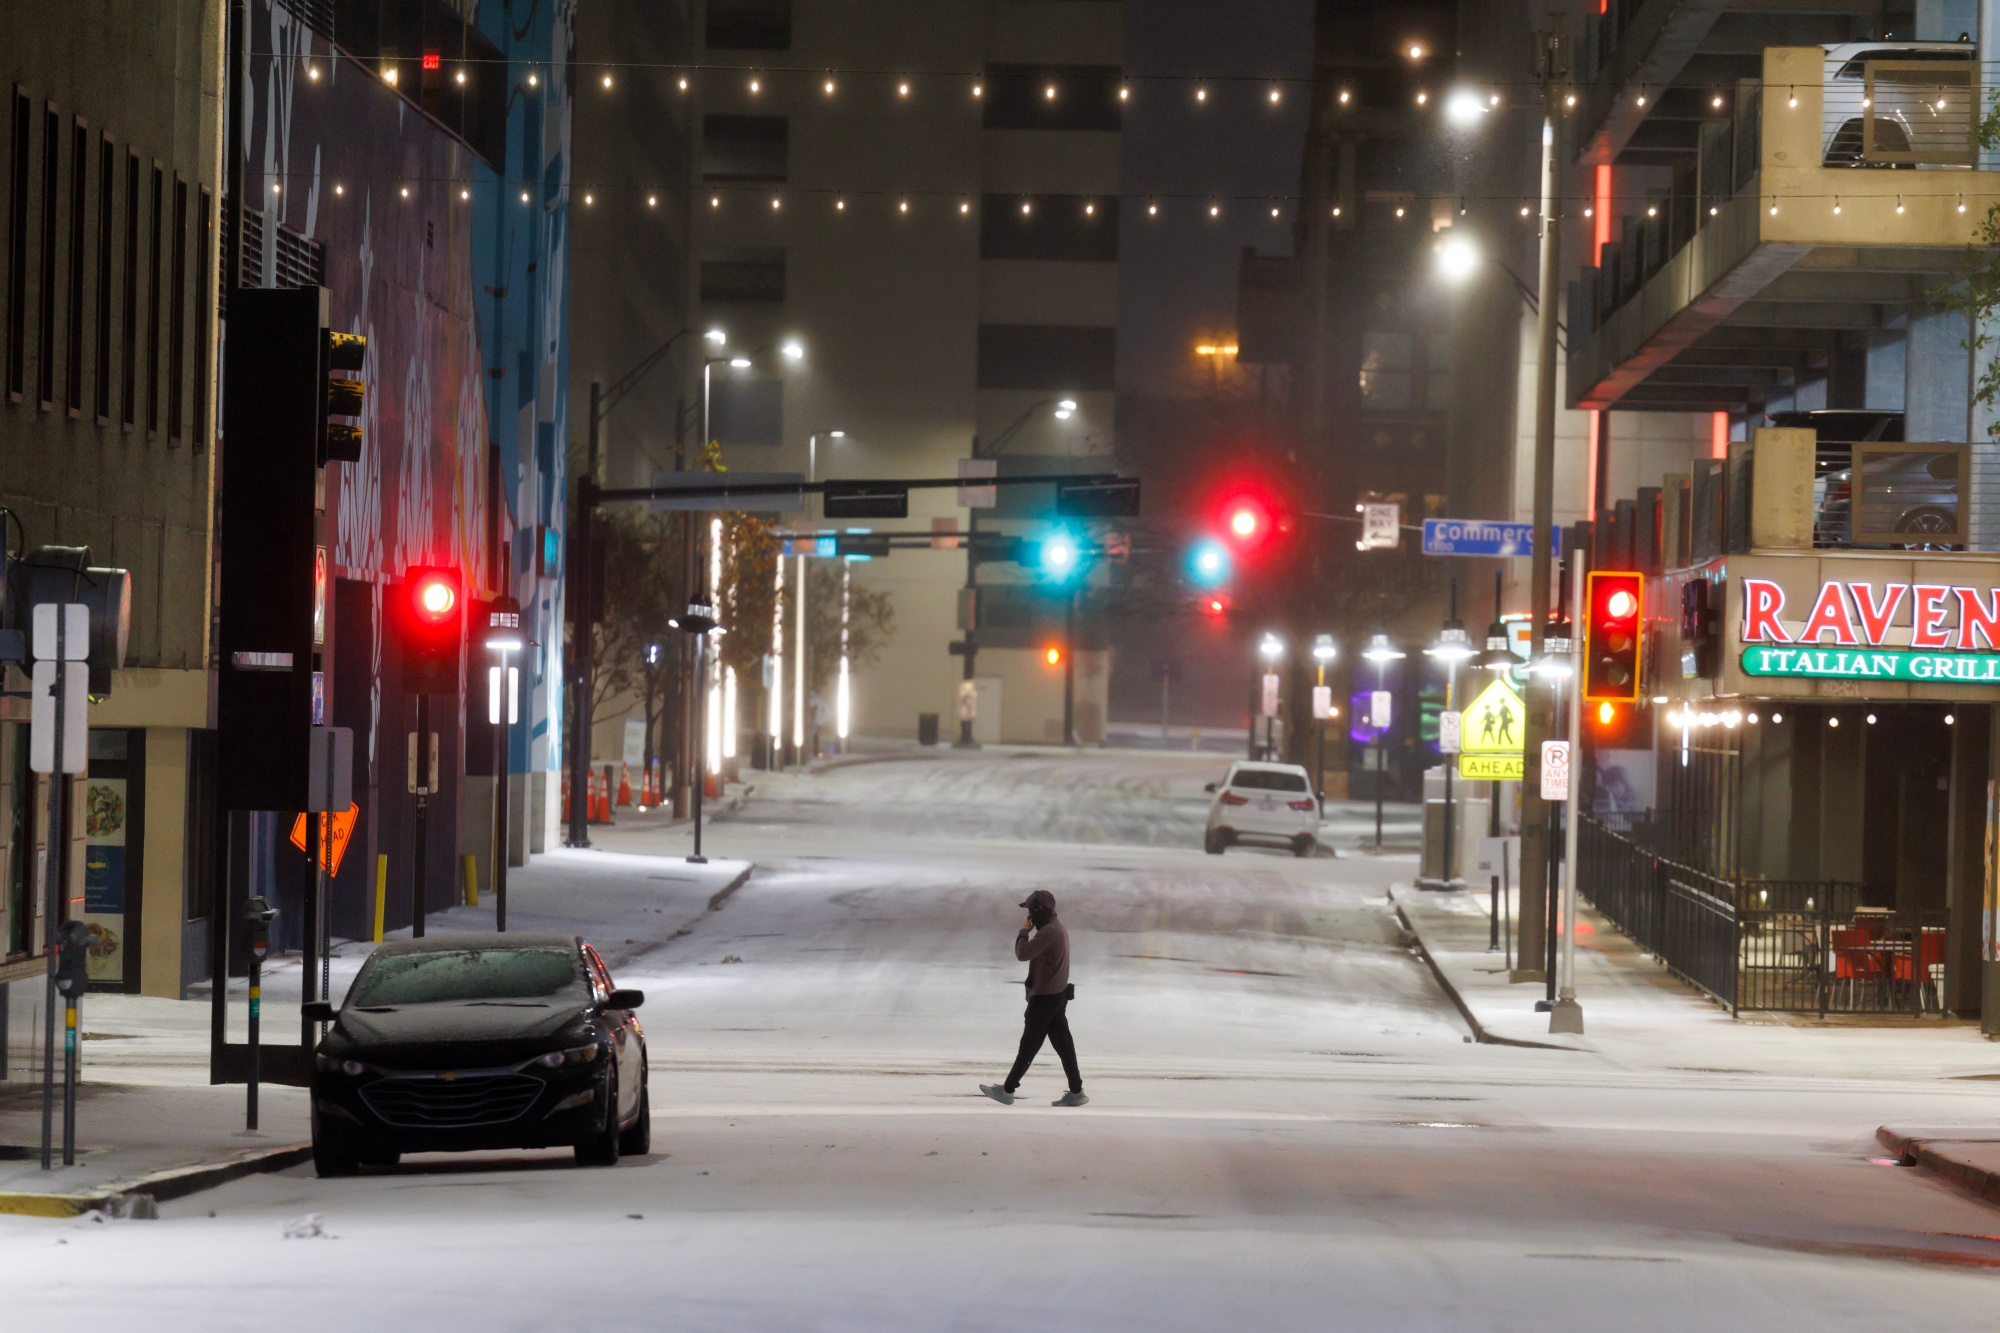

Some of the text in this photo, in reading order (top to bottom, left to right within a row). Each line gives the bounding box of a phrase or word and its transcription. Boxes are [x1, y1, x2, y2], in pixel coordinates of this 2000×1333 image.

[1370, 507, 1393, 517] ONE
[1370, 517, 1393, 528] WAY
[1434, 523, 1535, 543] Commerc
[1759, 649, 2000, 680] ITALIAN GRILL
[1468, 760, 1524, 774] AHEAD
[1545, 769, 1569, 778] ANY
[1545, 778, 1569, 788] TIME
